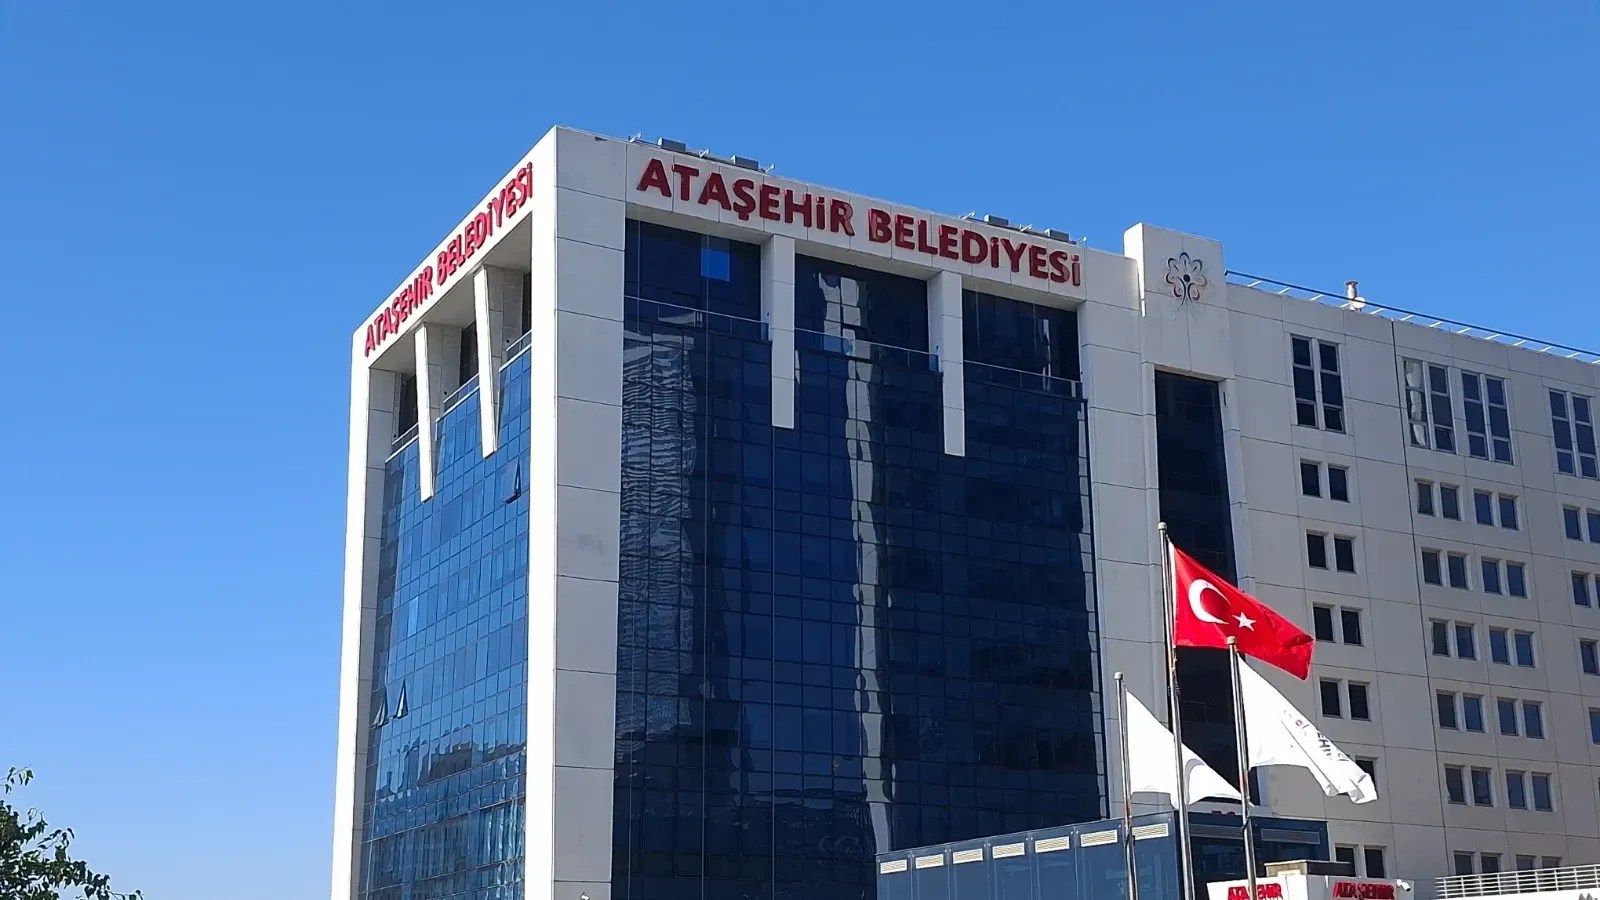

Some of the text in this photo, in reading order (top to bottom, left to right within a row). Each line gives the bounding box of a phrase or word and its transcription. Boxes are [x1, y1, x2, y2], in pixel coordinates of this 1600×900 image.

[365, 162, 533, 357] ATAŞEHİR BELEDİYESİ
[636, 158, 1081, 287] ATAŞEHİR BELEDİYESİ
